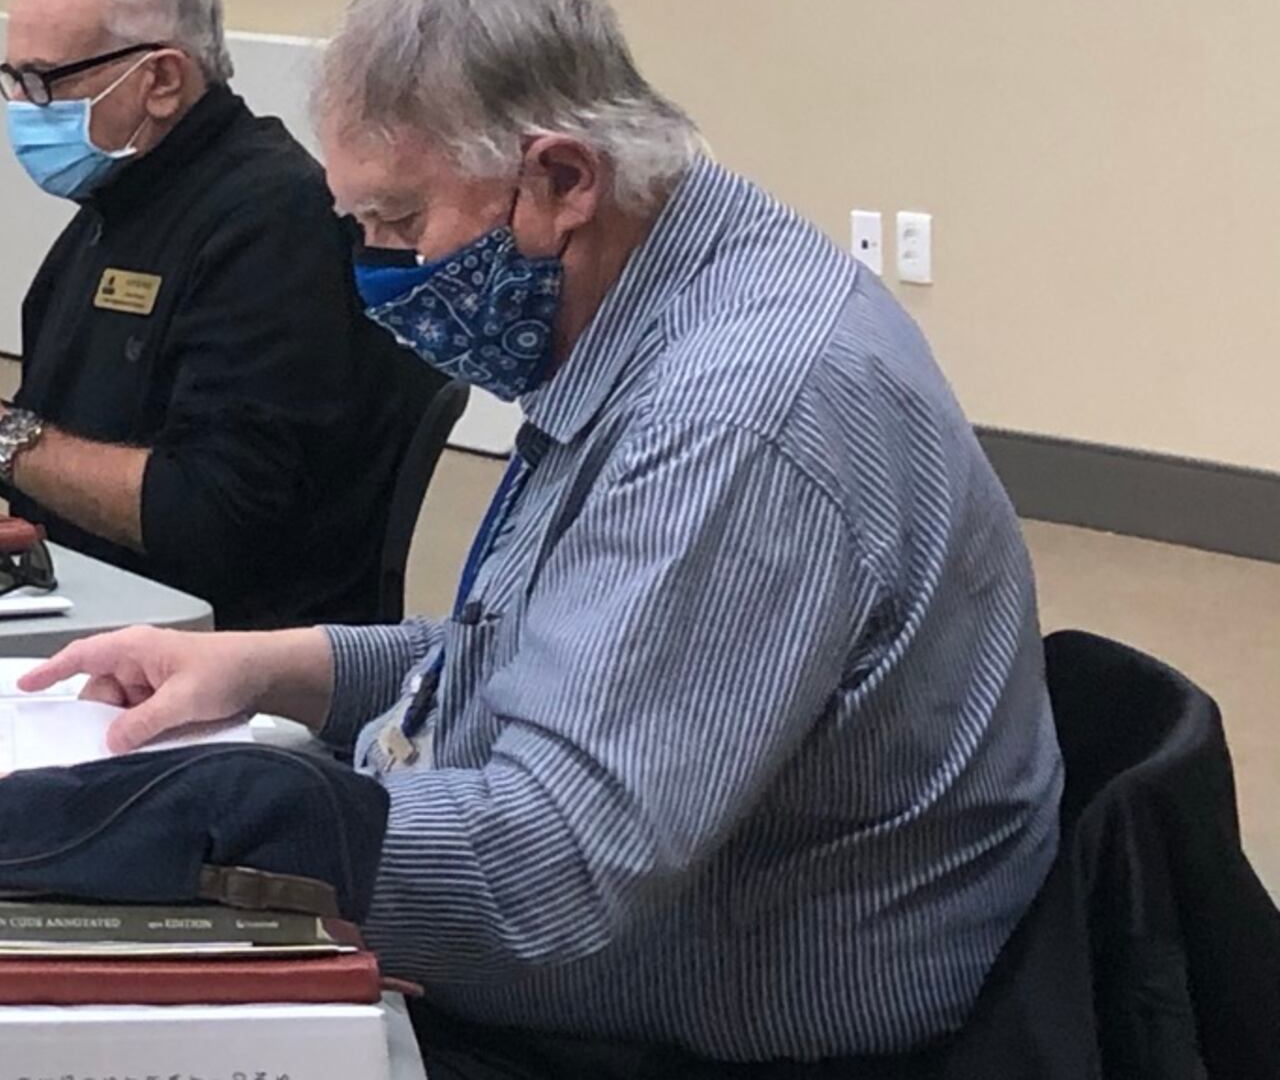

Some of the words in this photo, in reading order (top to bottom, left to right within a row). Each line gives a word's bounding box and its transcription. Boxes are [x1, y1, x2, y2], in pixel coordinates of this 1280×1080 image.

[9, 917, 43, 928] CODE
[46, 917, 122, 929] ANNOTATED
[164, 918, 213, 929] EDITION
